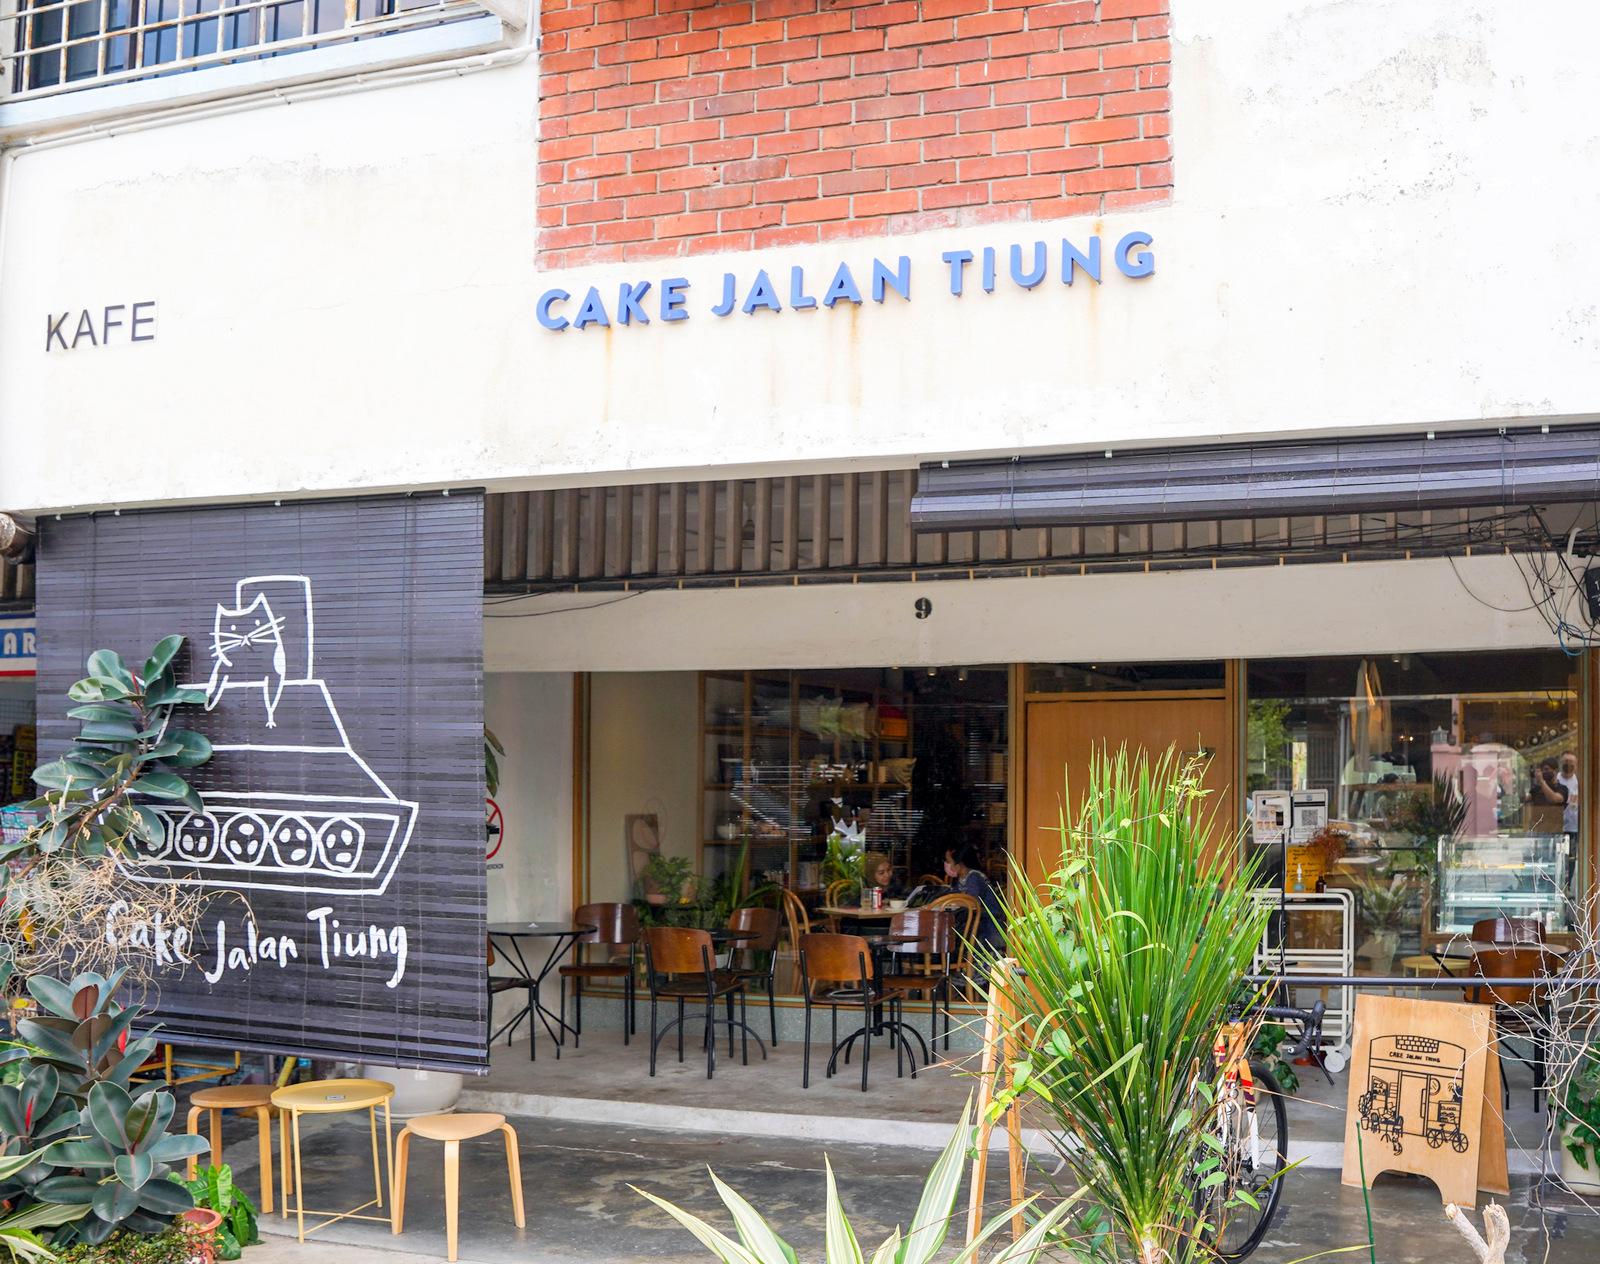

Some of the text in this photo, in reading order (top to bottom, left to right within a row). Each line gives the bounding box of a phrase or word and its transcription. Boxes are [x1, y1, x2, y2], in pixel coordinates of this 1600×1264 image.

[536, 231, 1156, 331] CAKE JALAN TIUNG
[46, 301, 156, 352] KAFE
[914, 597, 933, 620] 9
[106, 899, 408, 989] Cake Jalan Tiung
